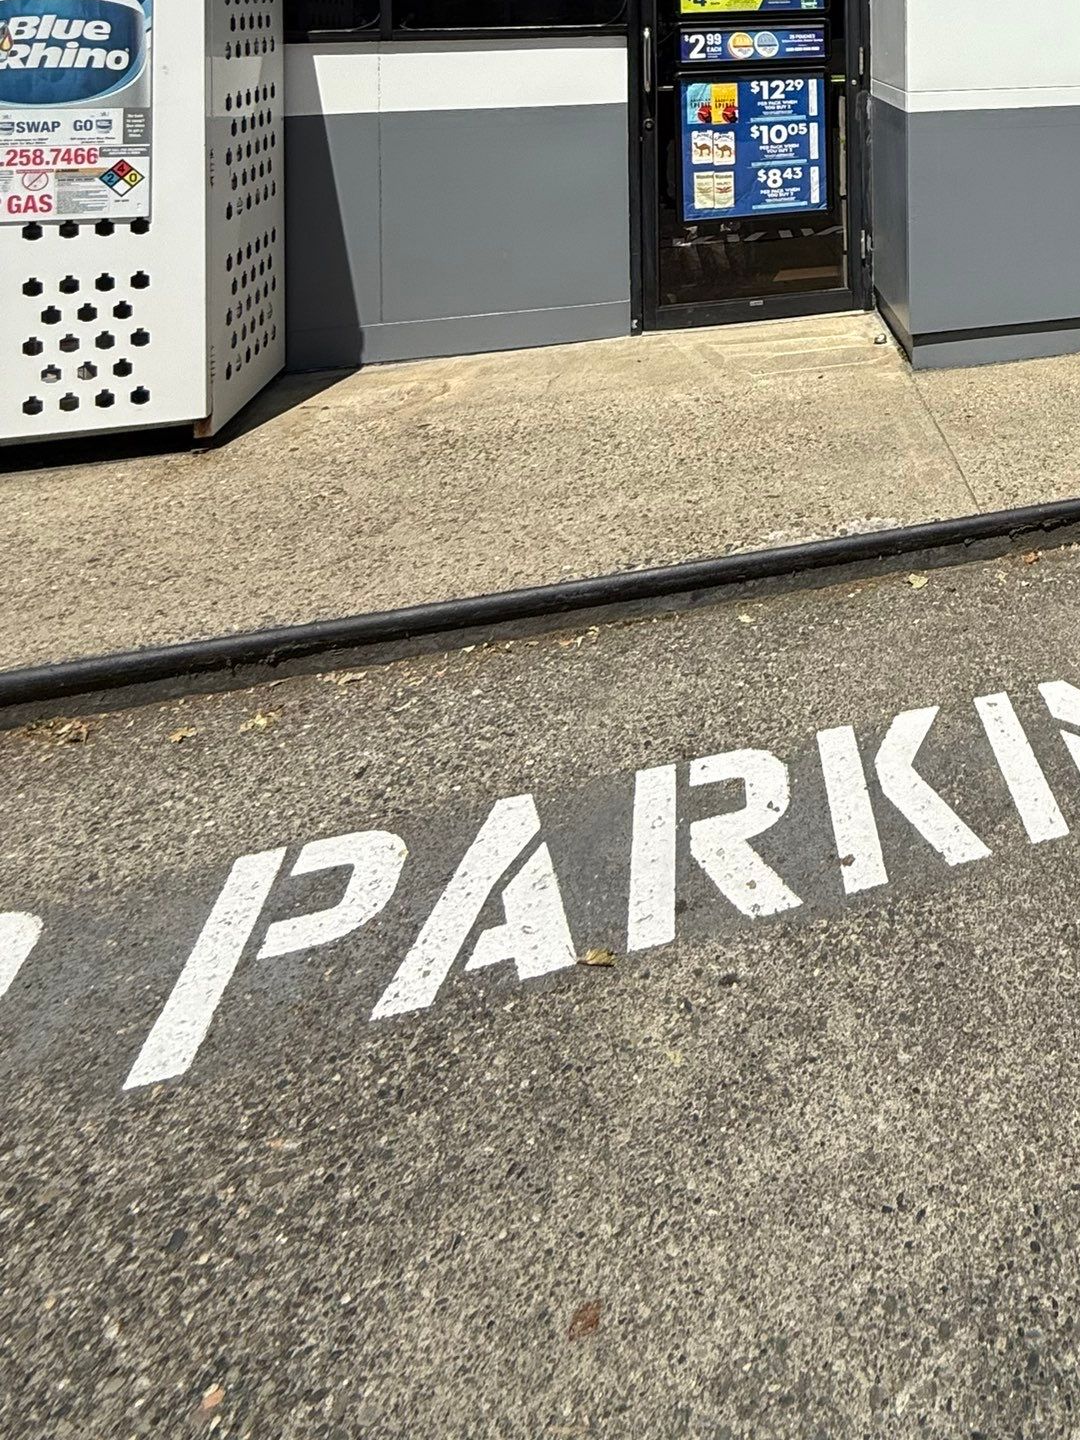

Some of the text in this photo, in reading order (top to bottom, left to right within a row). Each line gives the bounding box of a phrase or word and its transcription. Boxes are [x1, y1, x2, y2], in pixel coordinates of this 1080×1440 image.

[9, 15, 111, 41] Blue
[0, 41, 129, 71] Rhino
[16, 120, 93, 133] SWAP GO
[117, 164, 125, 173] 4
[107, 173, 137, 183] 2 0
[7, 194, 53, 214] GAS
